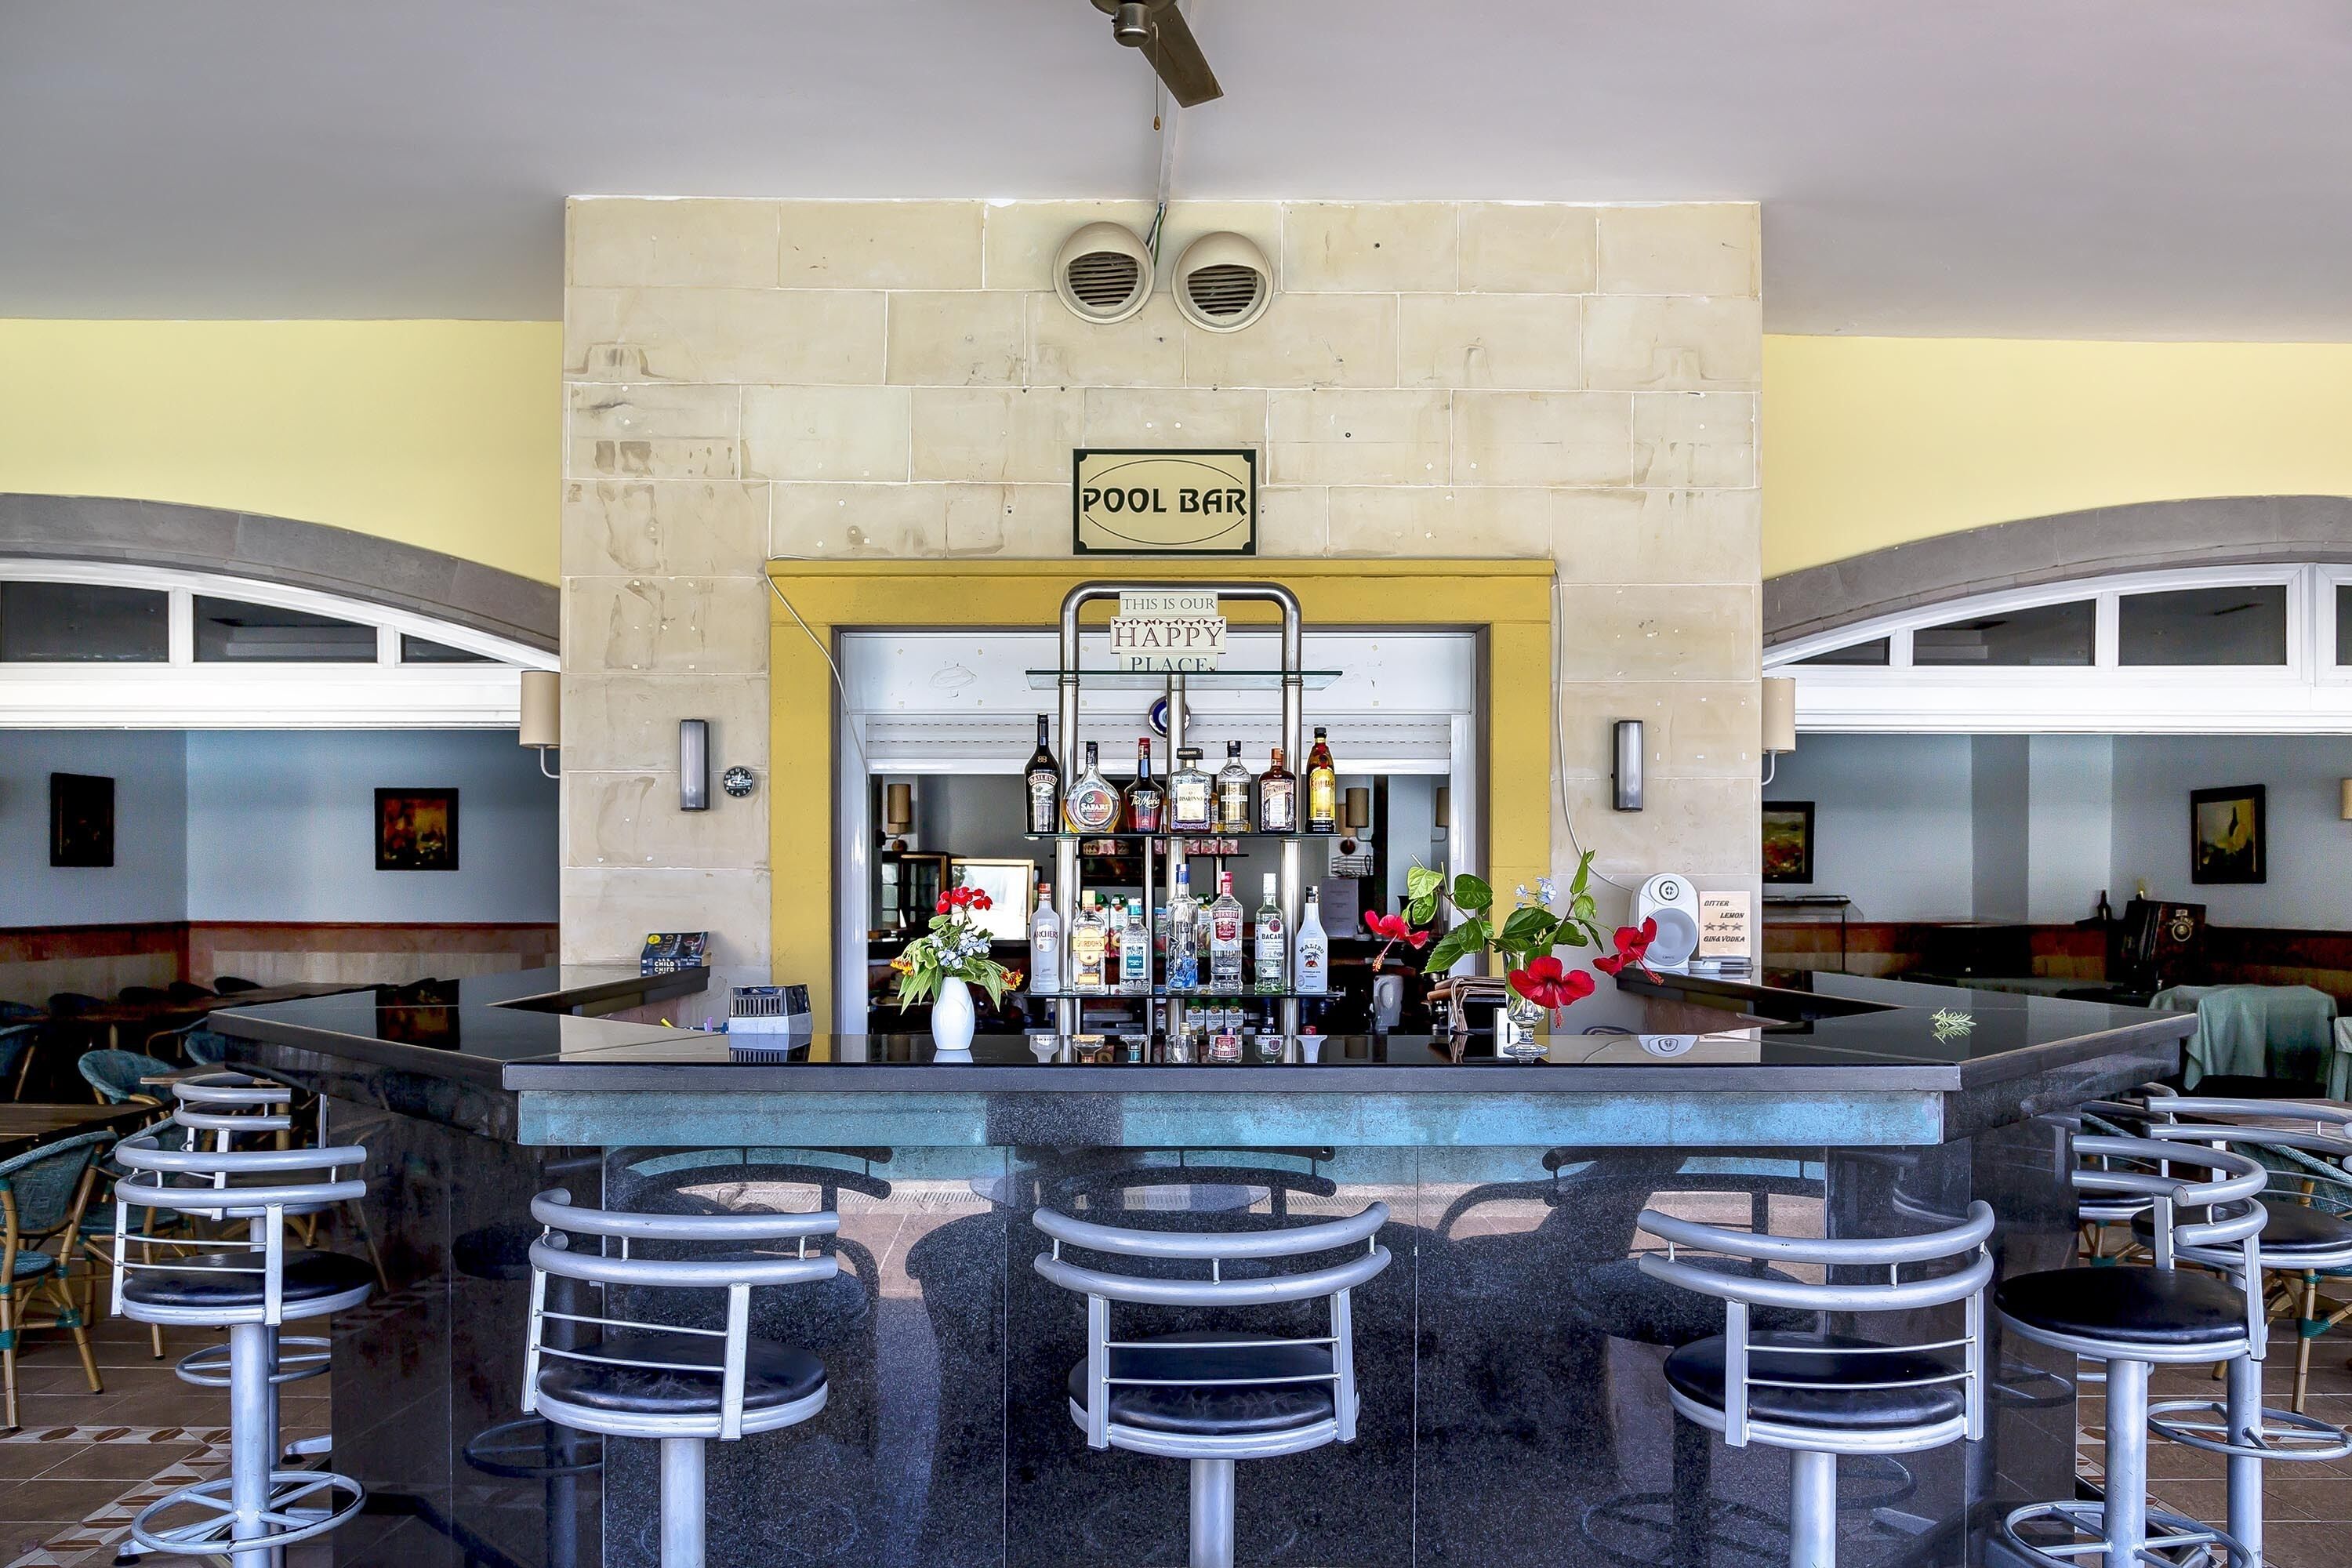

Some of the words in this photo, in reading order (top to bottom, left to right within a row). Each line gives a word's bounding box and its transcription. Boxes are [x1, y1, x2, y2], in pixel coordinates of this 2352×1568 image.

[1083, 488, 1167, 514] POOL
[1179, 488, 1247, 516] BAR
[1122, 598, 1158, 610] THIS
[1163, 598, 1175, 610] IS
[1180, 598, 1215, 610] OUR
[1114, 626, 1223, 647] HAPPY
[1131, 657, 1207, 671] PLACE
[1029, 775, 1056, 783] BAILEYS
[1130, 794, 1142, 806] Tia
[1141, 795, 1160, 808] Maria
[1033, 930, 1058, 938] ARCHERS
[1299, 943, 1325, 954] MALIBU
